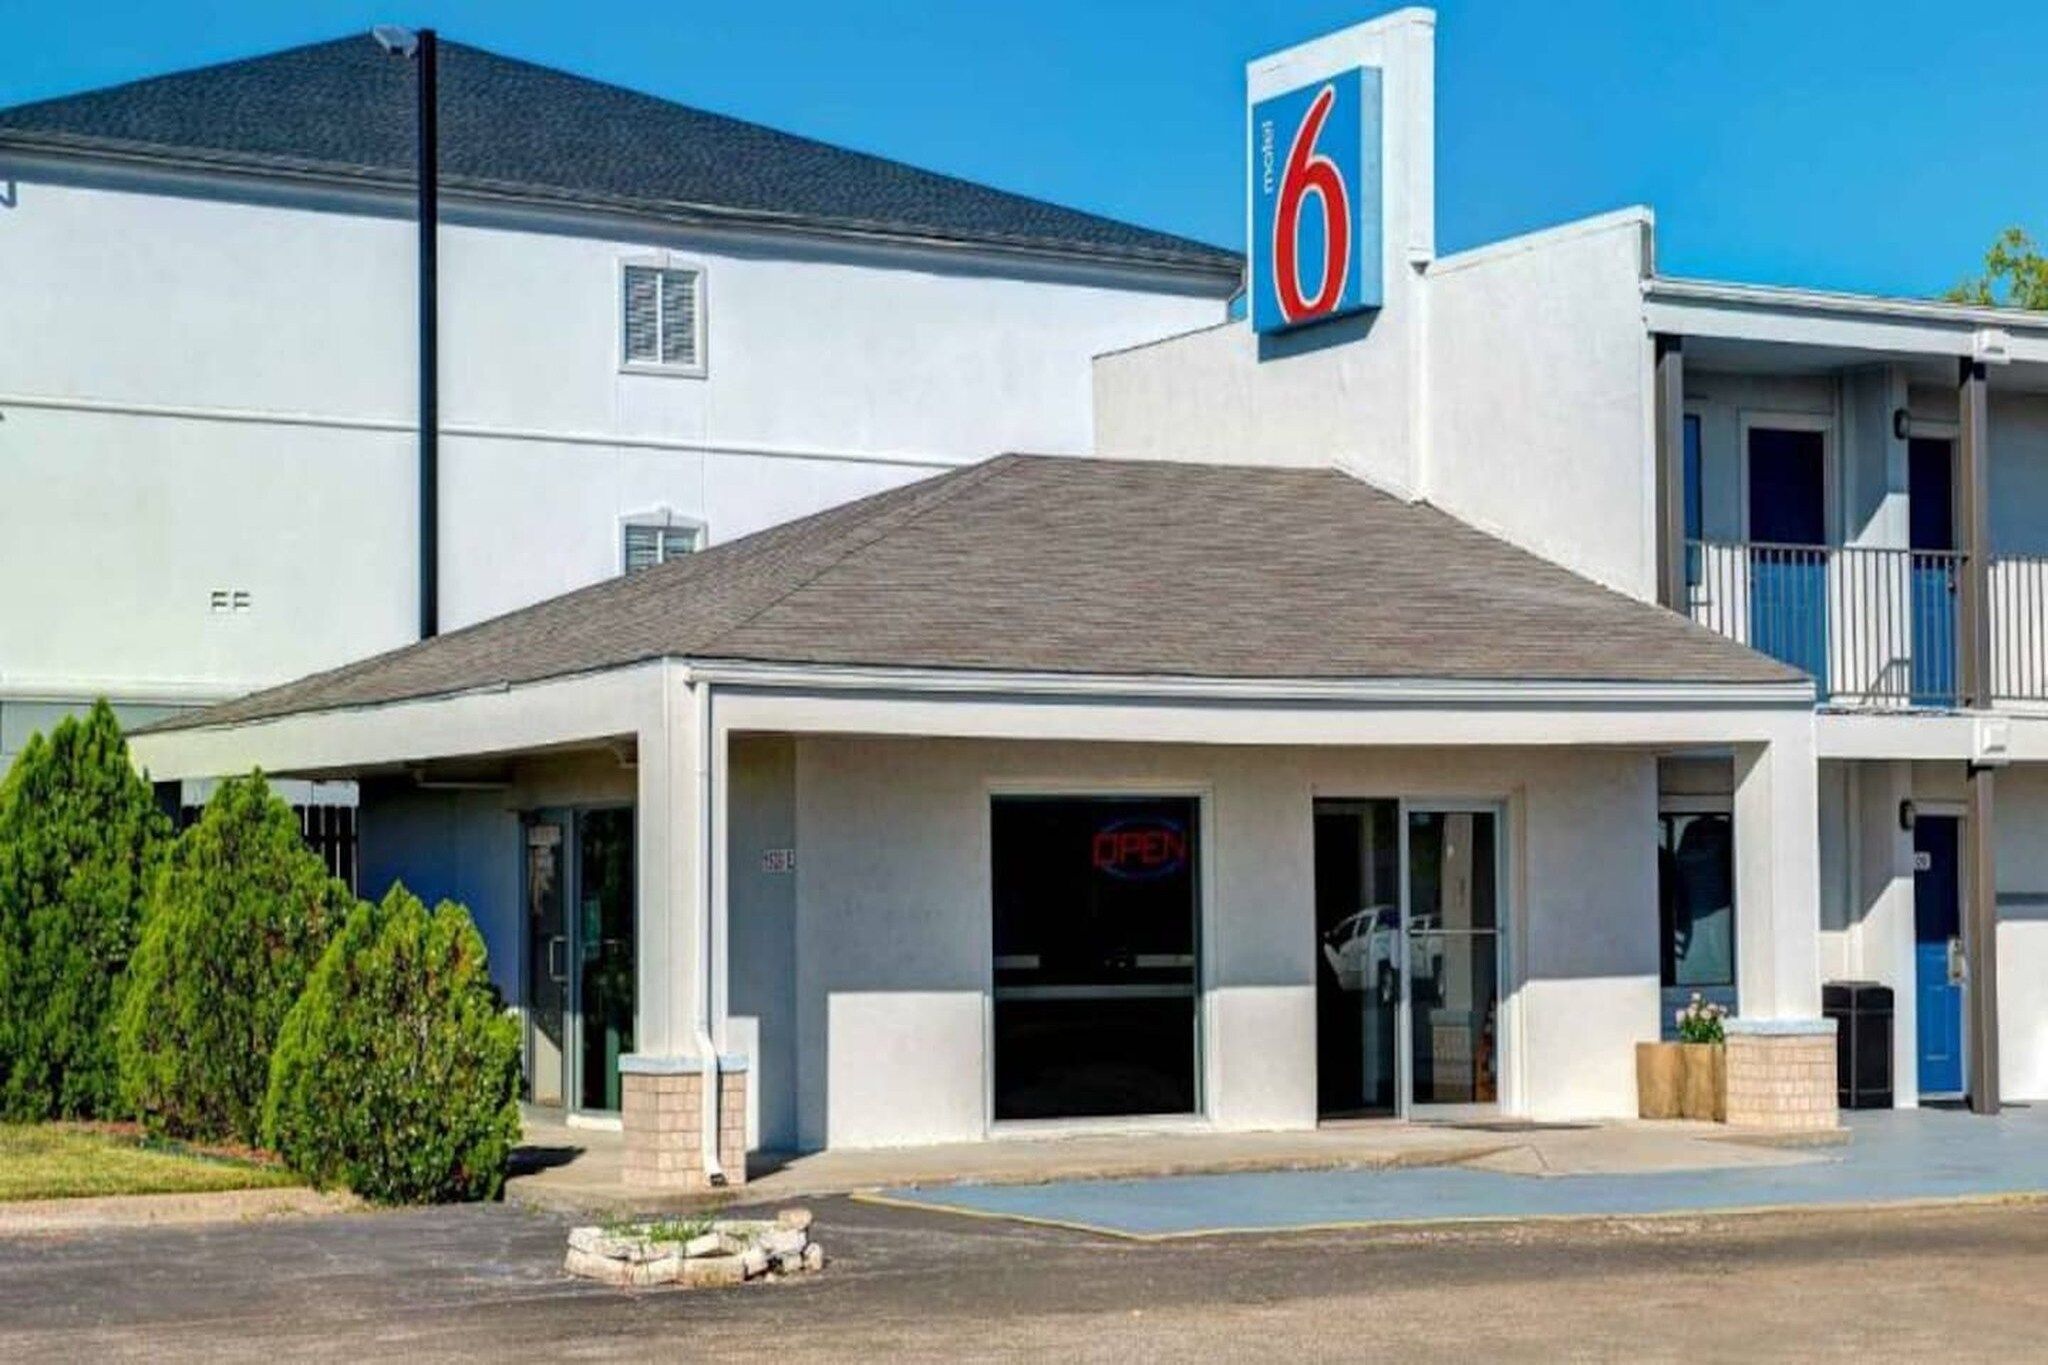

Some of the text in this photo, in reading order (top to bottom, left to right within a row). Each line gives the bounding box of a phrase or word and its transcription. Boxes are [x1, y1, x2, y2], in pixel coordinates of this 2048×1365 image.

[1262, 121, 1275, 194] motel
[1272, 84, 1350, 324] 6
[1091, 829, 1187, 869] OPEN
